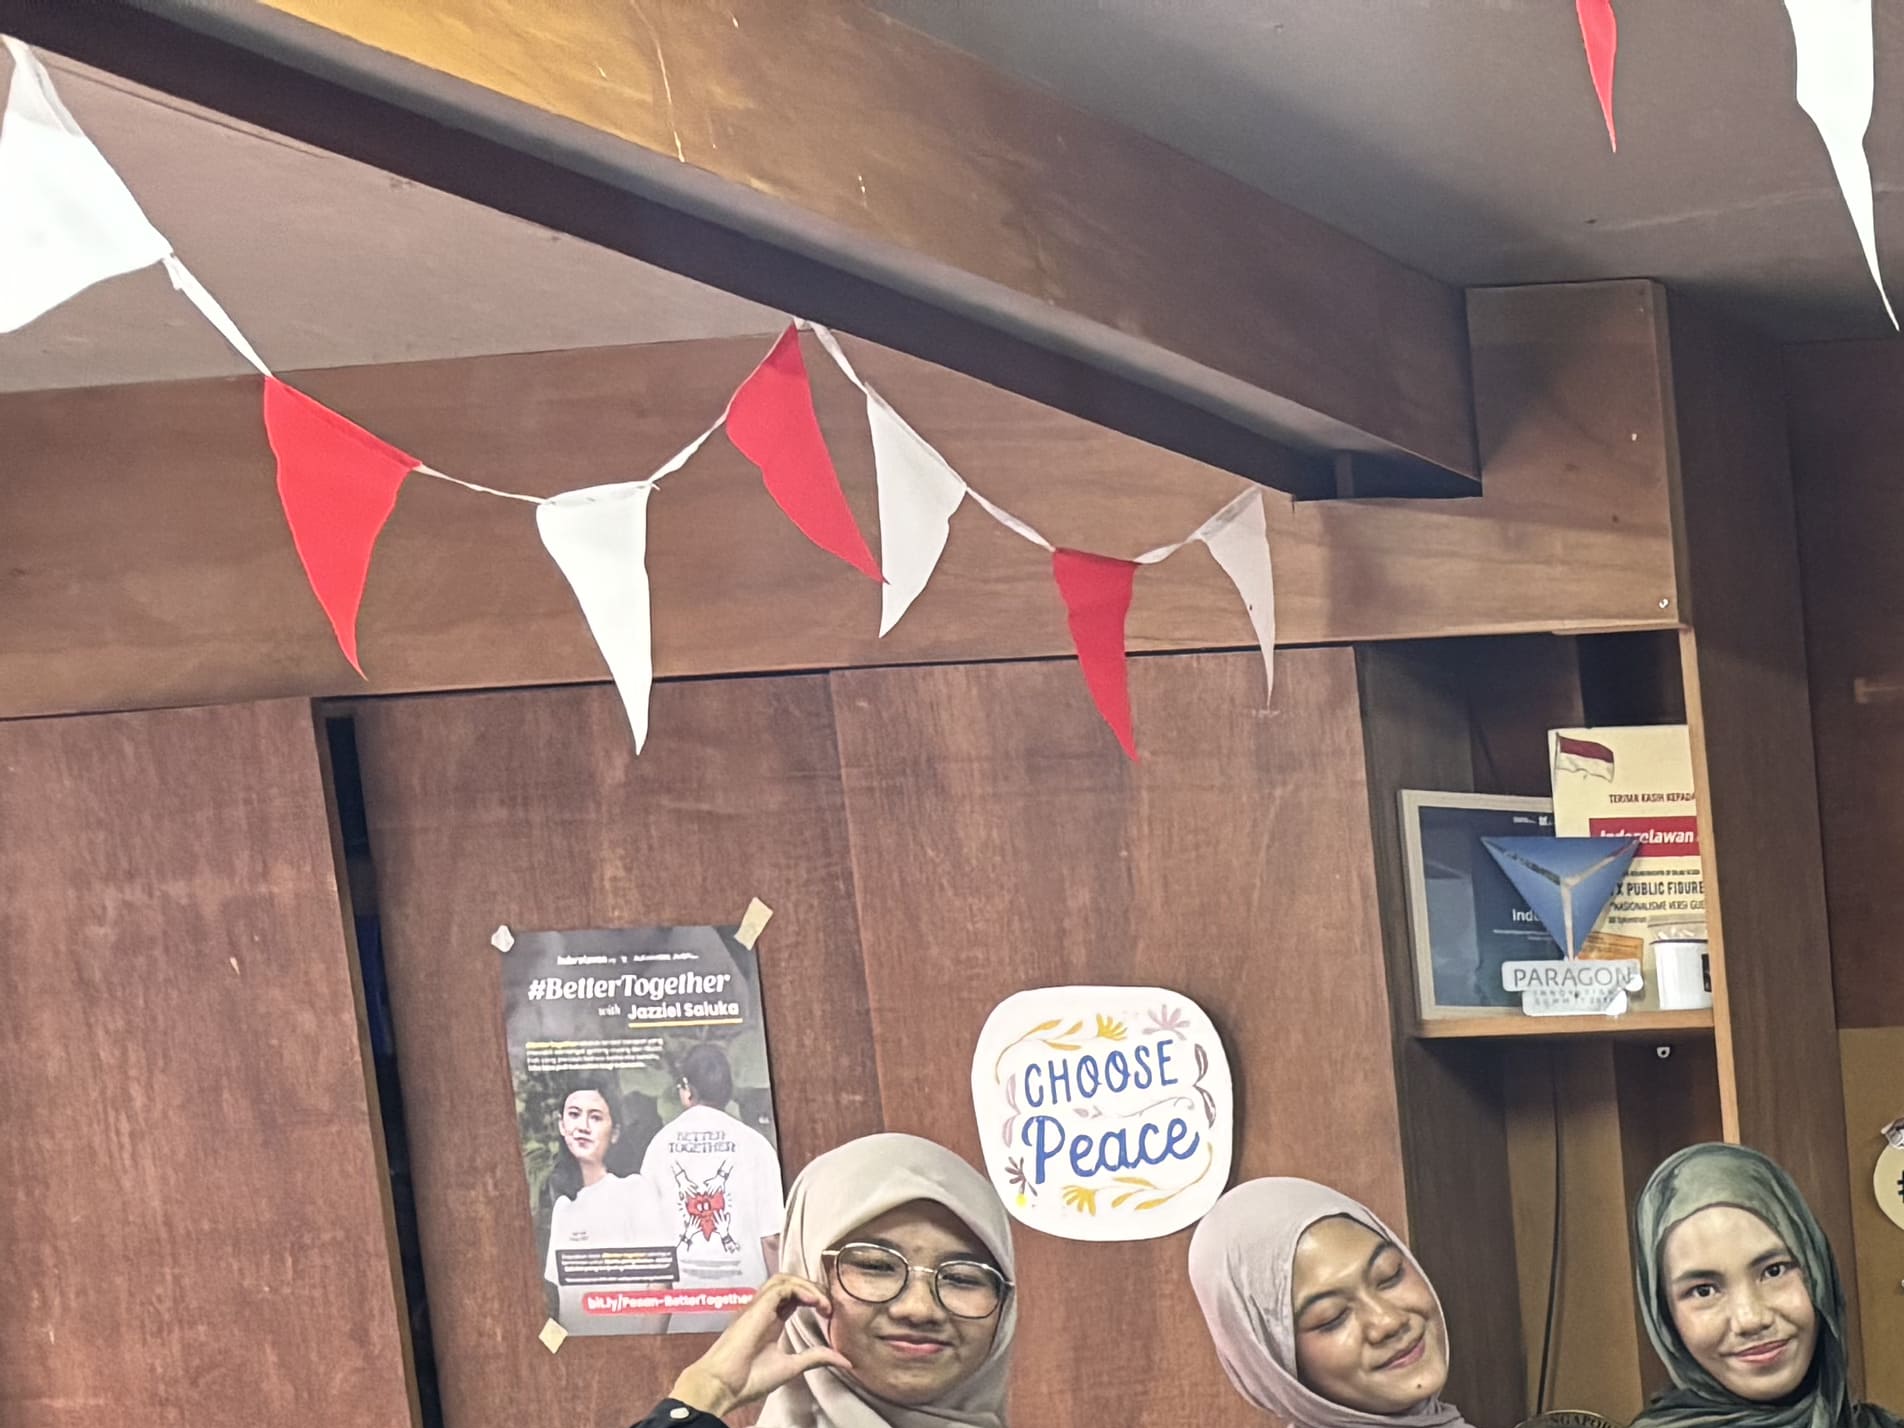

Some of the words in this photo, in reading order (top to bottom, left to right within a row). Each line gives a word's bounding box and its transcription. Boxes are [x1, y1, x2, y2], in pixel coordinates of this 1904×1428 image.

[1627, 882, 1665, 896] PUBLIC
[1667, 881, 1705, 895] FIGURE
[527, 971, 731, 1001] #BetterTogether
[1514, 967, 1633, 988] PARAGON
[684, 1001, 739, 1018] Saluka
[1024, 1039, 1178, 1108] CHOOSE
[1021, 1115, 1200, 1185] Peace
